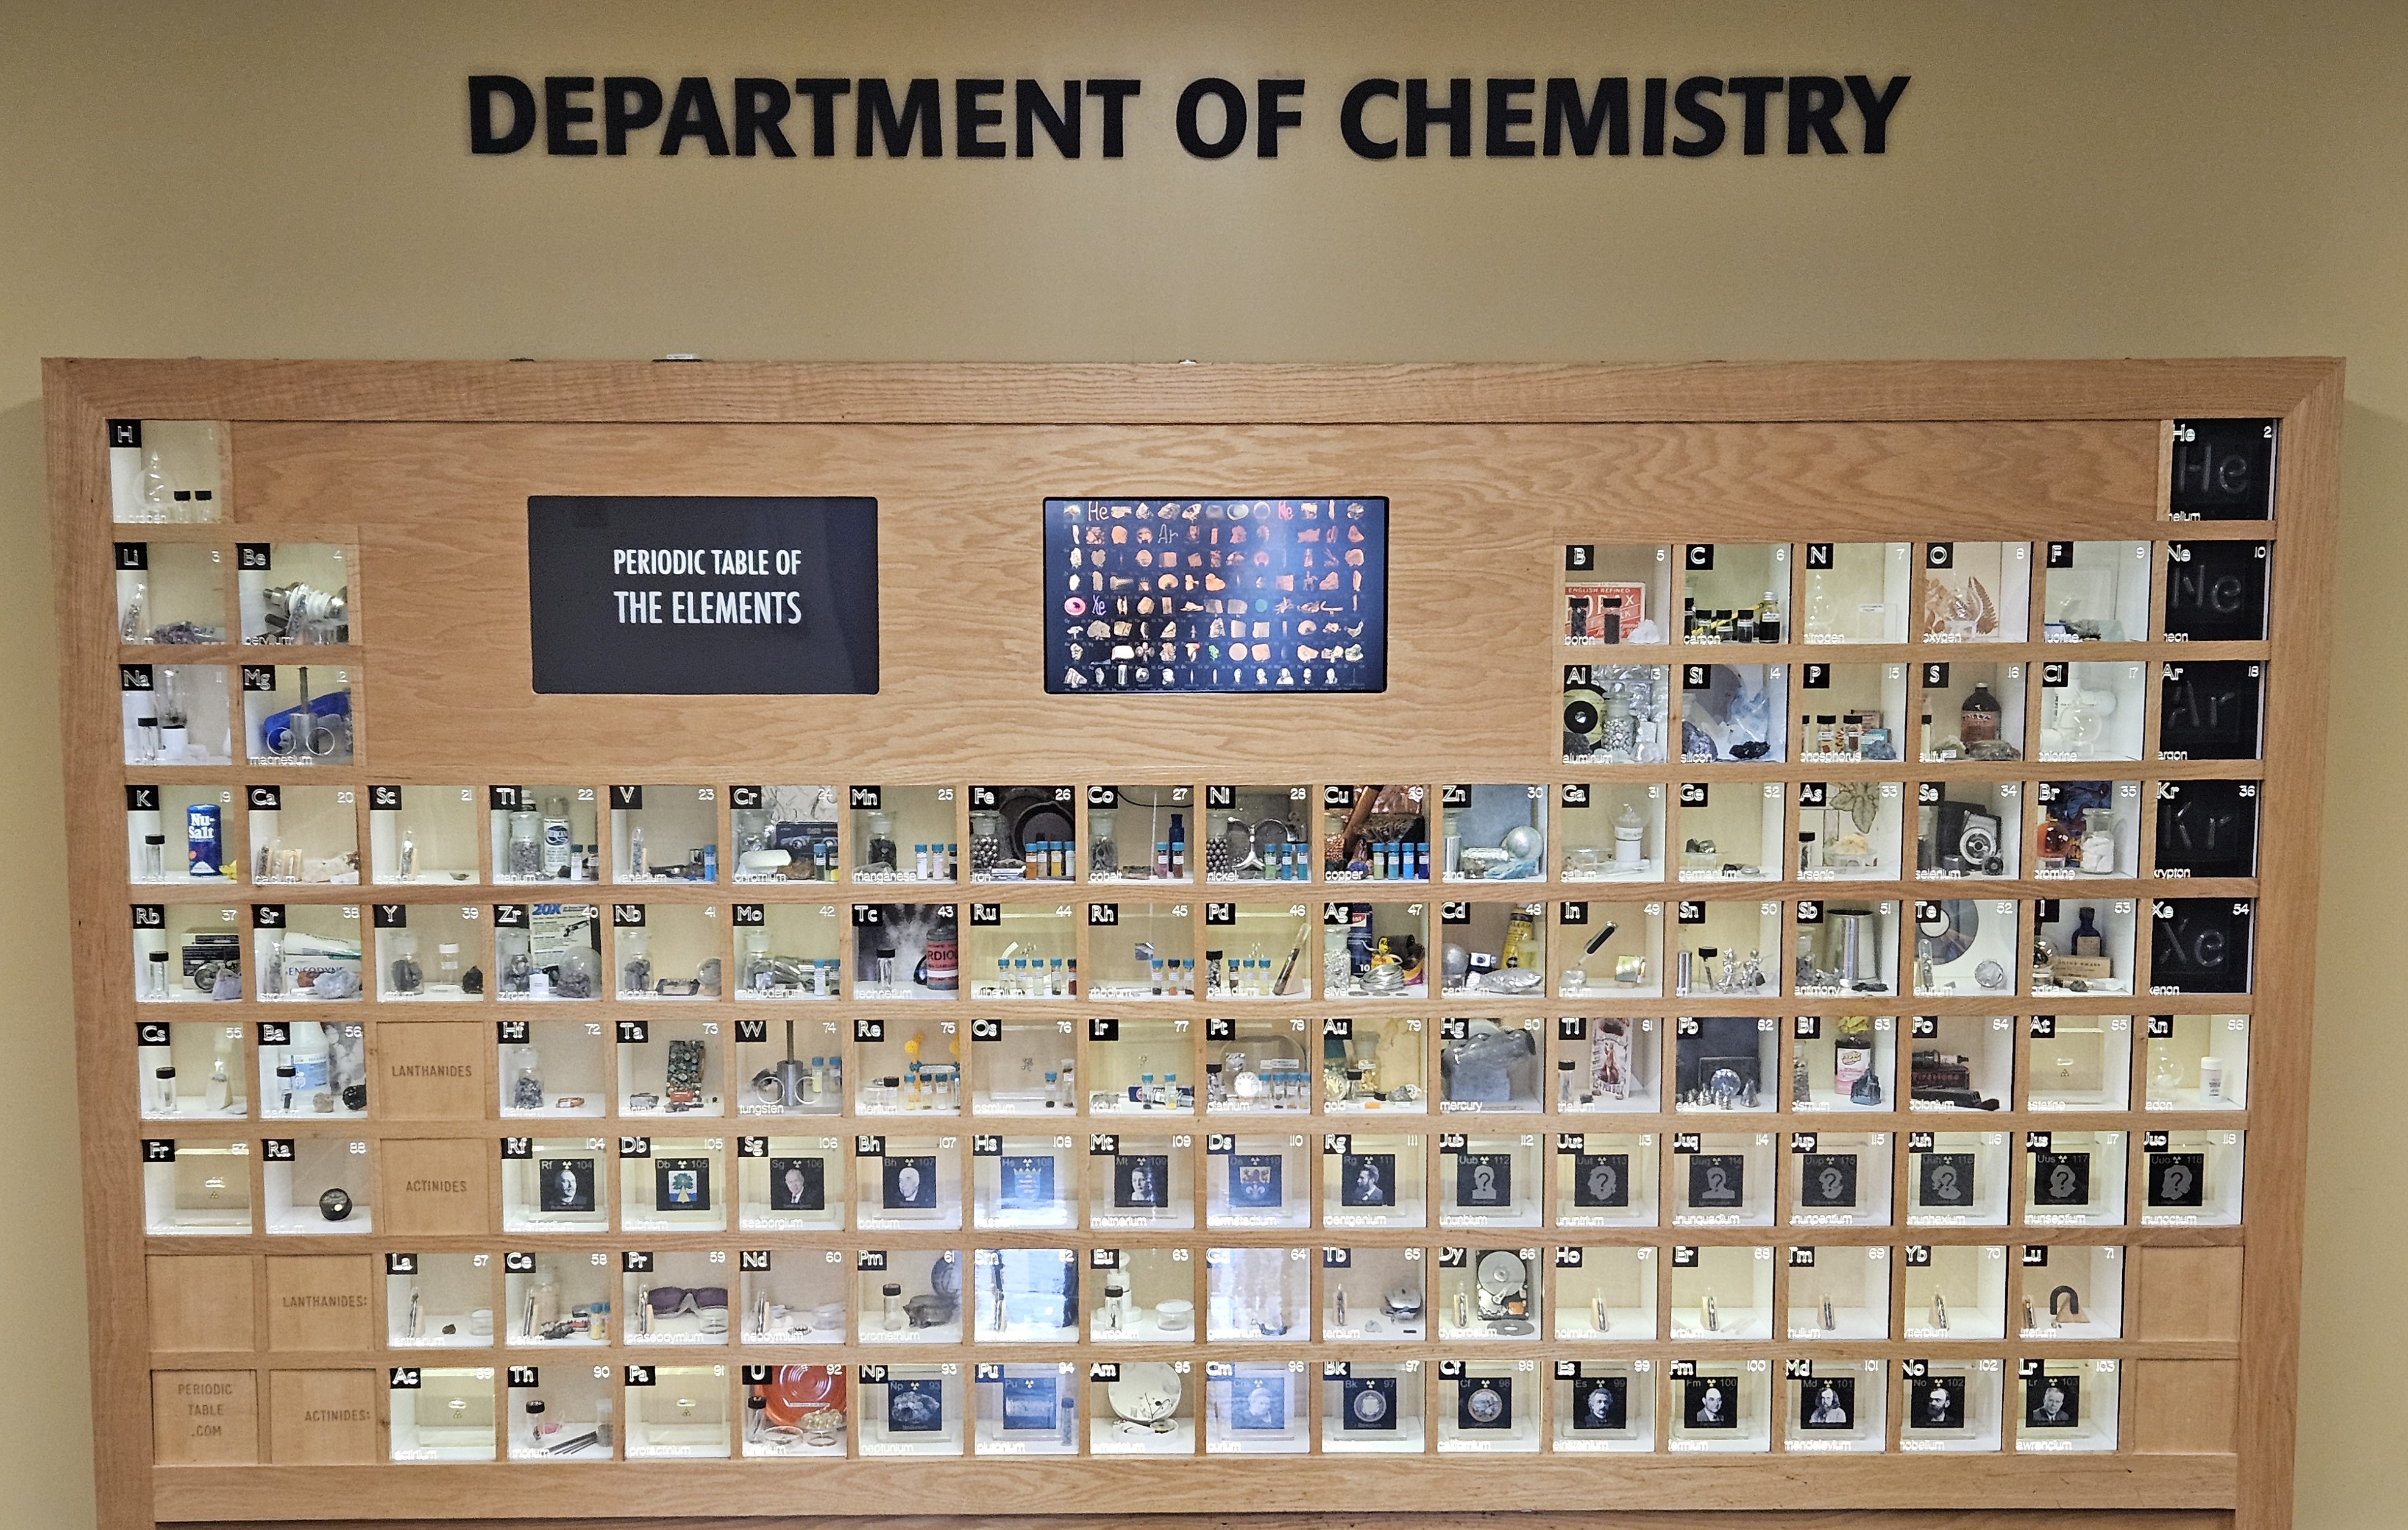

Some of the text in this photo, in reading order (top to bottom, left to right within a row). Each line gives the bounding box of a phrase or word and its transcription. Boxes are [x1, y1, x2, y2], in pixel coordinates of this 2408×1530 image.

[467, 74, 1911, 161] DEPARTMENT OF CHEMISTRY
[118, 426, 133, 443] H
[2172, 425, 2195, 441] He
[244, 549, 266, 567] Be
[1574, 548, 1585, 564] B
[1691, 548, 1706, 564] C
[1810, 547, 1827, 564] N
[1930, 547, 1947, 564] O
[2051, 545, 2062, 562] F
[2167, 545, 2190, 562] Ne
[613, 550, 801, 575] PERIODIC TABLE OF
[614, 592, 802, 625] THE ELEMENTS
[124, 671, 149, 687] Na
[245, 670, 270, 690] Mg
[1567, 668, 1585, 684] Al
[1810, 667, 1821, 682] P
[1930, 667, 1940, 682] S
[2043, 665, 2062, 682] Cl
[2162, 664, 2183, 680] Ar
[137, 791, 151, 806] K
[252, 790, 275, 806] Ca
[376, 790, 396, 805] Sc
[619, 787, 634, 803] V
[733, 789, 757, 804] Cr
[852, 789, 878, 804] Mn
[975, 788, 995, 804] Fe
[1089, 787, 1113, 804] Co
[1324, 787, 1349, 804] Cu
[1443, 787, 1466, 802] Zn
[1800, 787, 1822, 801] As
[1919, 784, 1939, 800] Se
[2039, 784, 2060, 801] Br
[2156, 782, 2179, 799] Kr
[136, 909, 160, 923] Rb
[260, 907, 278, 923] Sr
[383, 906, 397, 922] Y
[498, 907, 521, 923] Zr
[616, 907, 641, 921] Nb
[737, 907, 762, 922] Mo
[854, 906, 878, 921] Tc
[974, 905, 996, 920] Ru
[1092, 905, 1113, 921] Rh
[1209, 905, 1229, 920] Pd
[1325, 905, 1349, 923] Ag
[1442, 903, 1465, 919] Cd
[1680, 904, 1699, 918] Sn
[2152, 903, 2173, 918] Xe
[143, 1025, 165, 1041] Cs
[263, 1025, 285, 1041] Ba
[621, 1022, 642, 1039] Ta
[741, 1022, 764, 1037] W
[858, 1021, 881, 1036] Re
[972, 1020, 996, 1036] Os
[1210, 1019, 1227, 1035] Pt
[1324, 1019, 1347, 1034] Au
[1441, 1018, 1464, 1036] Hg
[1912, 1018, 1932, 1033] Po
[392, 1064, 472, 1078] LANTHANIDES
[745, 1136, 764, 1156] Sg
[859, 1136, 879, 1152] Bh
[2037, 1154, 2056, 1164] Uus
[406, 1180, 467, 1192] ACTINIDES
[507, 1254, 531, 1269] Ce
[628, 1253, 647, 1269] Pr
[744, 1252, 767, 1267] Nd
[858, 1251, 883, 1266] Pm
[283, 1295, 367, 1308] LANTHANIDES:
[509, 1367, 533, 1383] Th
[861, 1364, 885, 1383] Np
[1091, 1363, 1117, 1378] Am
[179, 1384, 232, 1395] PERIODIC
[1914, 1378, 1927, 1387] No
[188, 1405, 224, 1415] TABLE
[305, 1410, 370, 1422] ACTINIDES:
[191, 1426, 222, 1436] .COM
